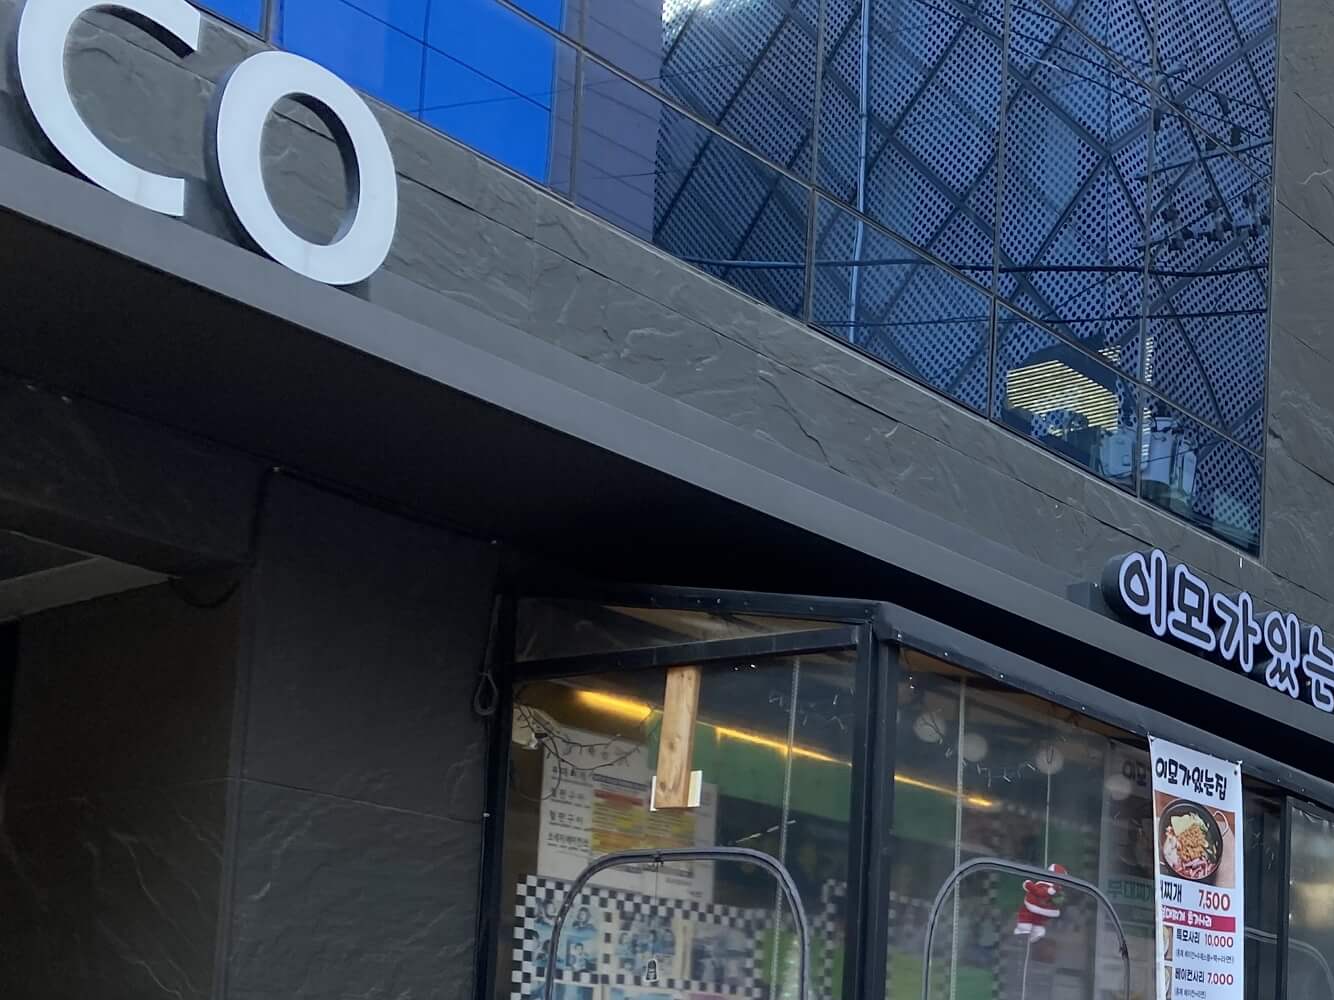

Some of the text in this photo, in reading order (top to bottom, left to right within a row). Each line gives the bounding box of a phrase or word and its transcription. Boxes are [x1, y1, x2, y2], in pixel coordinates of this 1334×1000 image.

[1198, 889, 1231, 911] 7,500
[1205, 933, 1234, 949] 10,000
[1207, 972, 1234, 986] 7,000
